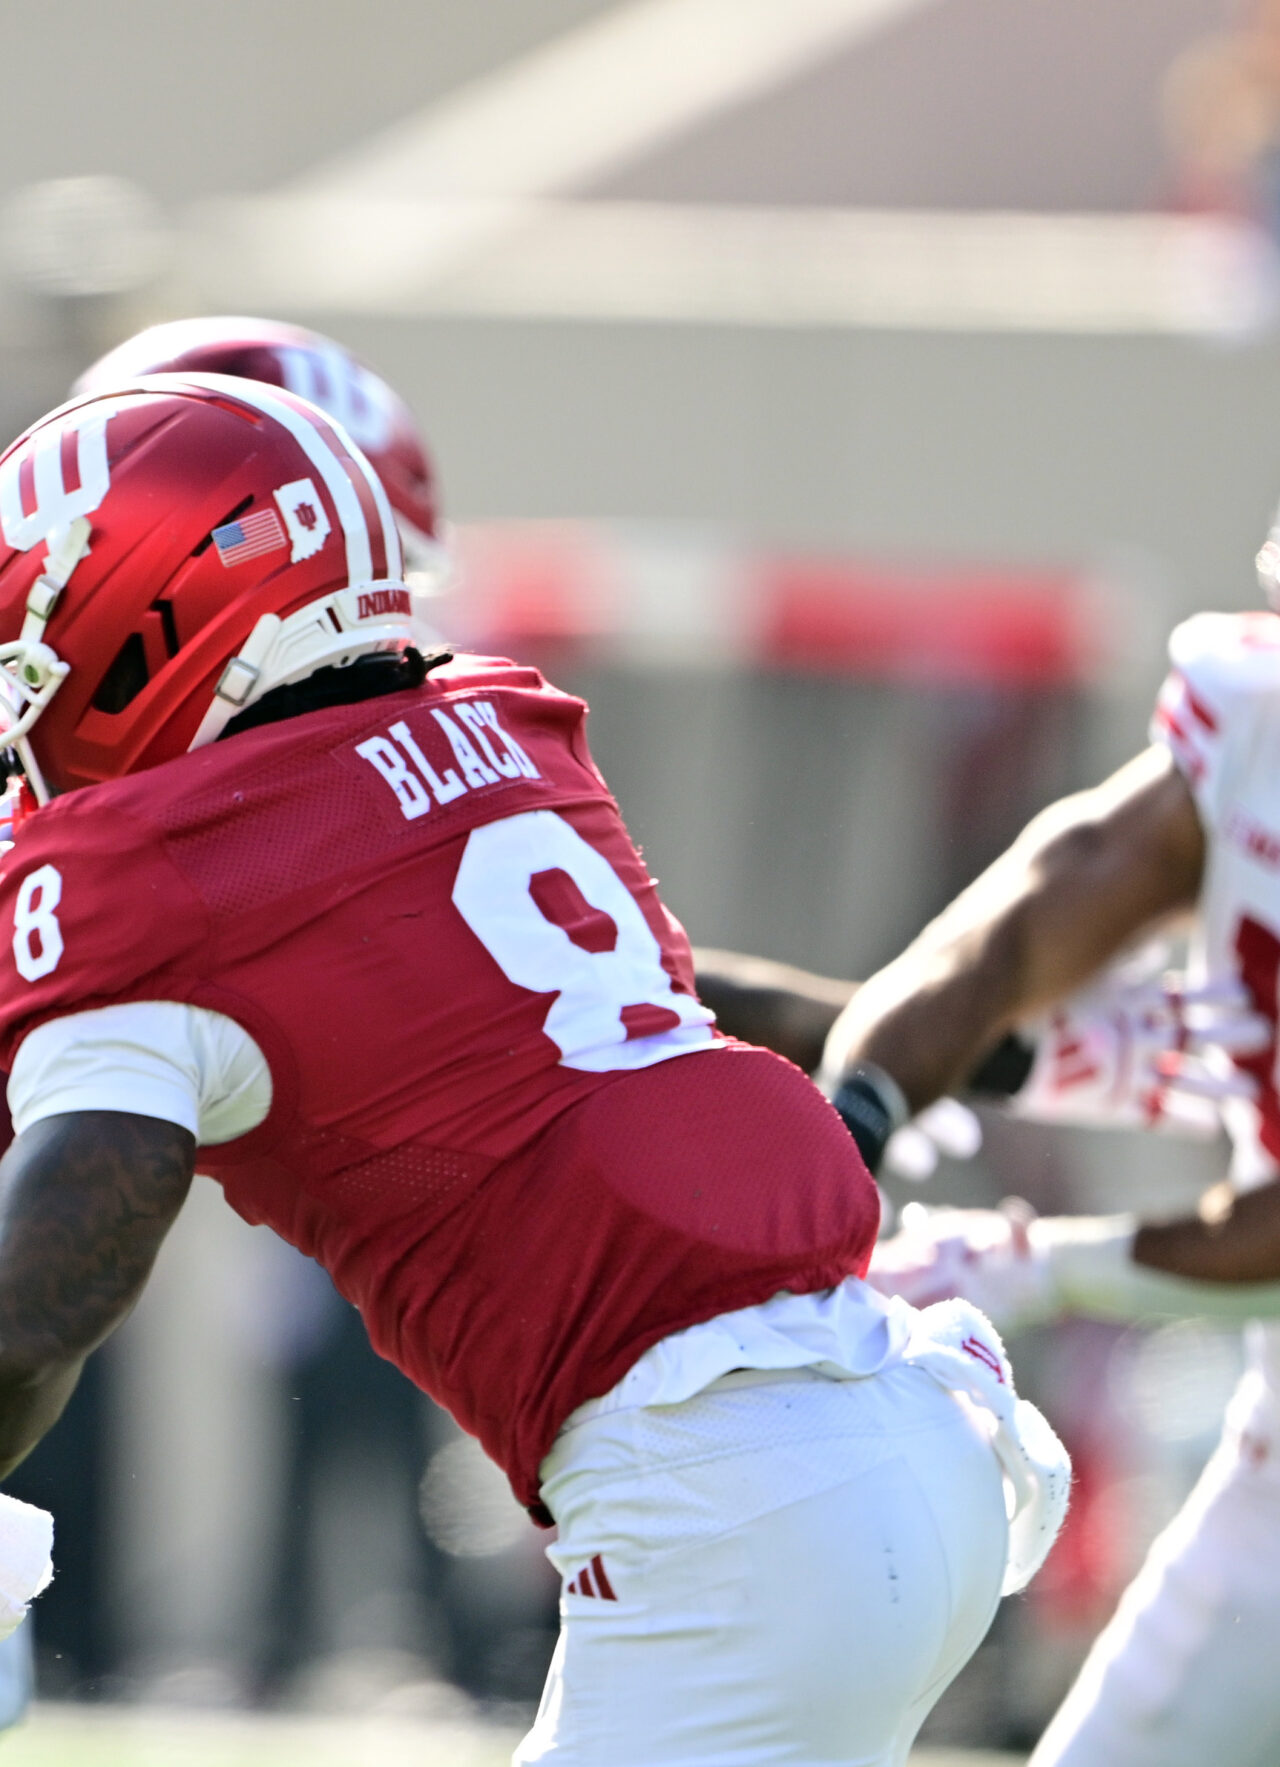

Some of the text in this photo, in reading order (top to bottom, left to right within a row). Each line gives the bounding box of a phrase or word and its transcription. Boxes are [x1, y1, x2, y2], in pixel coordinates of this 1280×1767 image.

[355, 701, 542, 821] BLACK
[13, 864, 65, 982] 8
[451, 810, 727, 1073] 8
